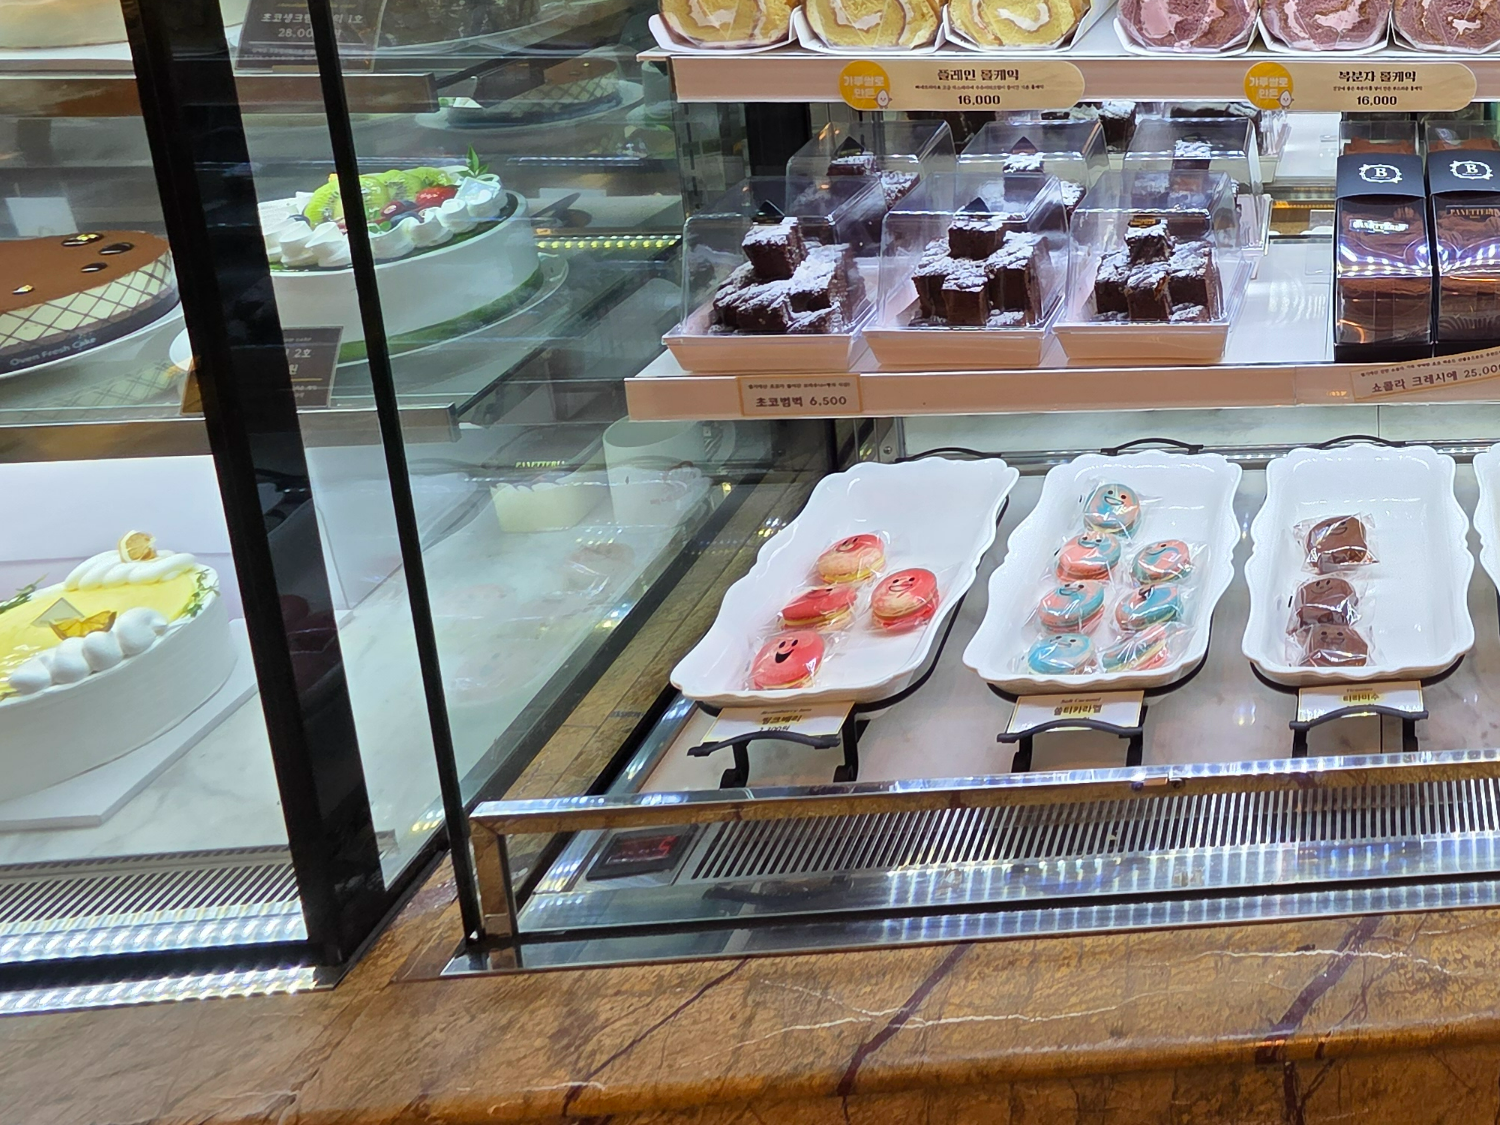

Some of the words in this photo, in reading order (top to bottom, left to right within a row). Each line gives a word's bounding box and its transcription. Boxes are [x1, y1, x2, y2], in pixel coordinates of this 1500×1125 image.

[937, 69, 976, 81] 플레인
[980, 69, 1020, 81] 롤케익
[1339, 70, 1377, 82] 복분자
[1380, 70, 1416, 82] 롤케익
[843, 76, 885, 87] 가루쌀로
[1249, 76, 1288, 87] 가루쌀로
[854, 88, 877, 99] 만든
[1259, 88, 1278, 99] 만든
[958, 94, 1001, 105] 16,000
[1356, 96, 1398, 106] 16,000
[1374, 167, 1388, 177] B
[1465, 163, 1479, 174] B
[1372, 378, 1406, 393] 쇼콜라
[1412, 370, 1458, 386] 크레시에
[756, 396, 803, 408] 초코범벅
[809, 395, 847, 406] 6,500
[1342, 693, 1380, 703] 티라미수
